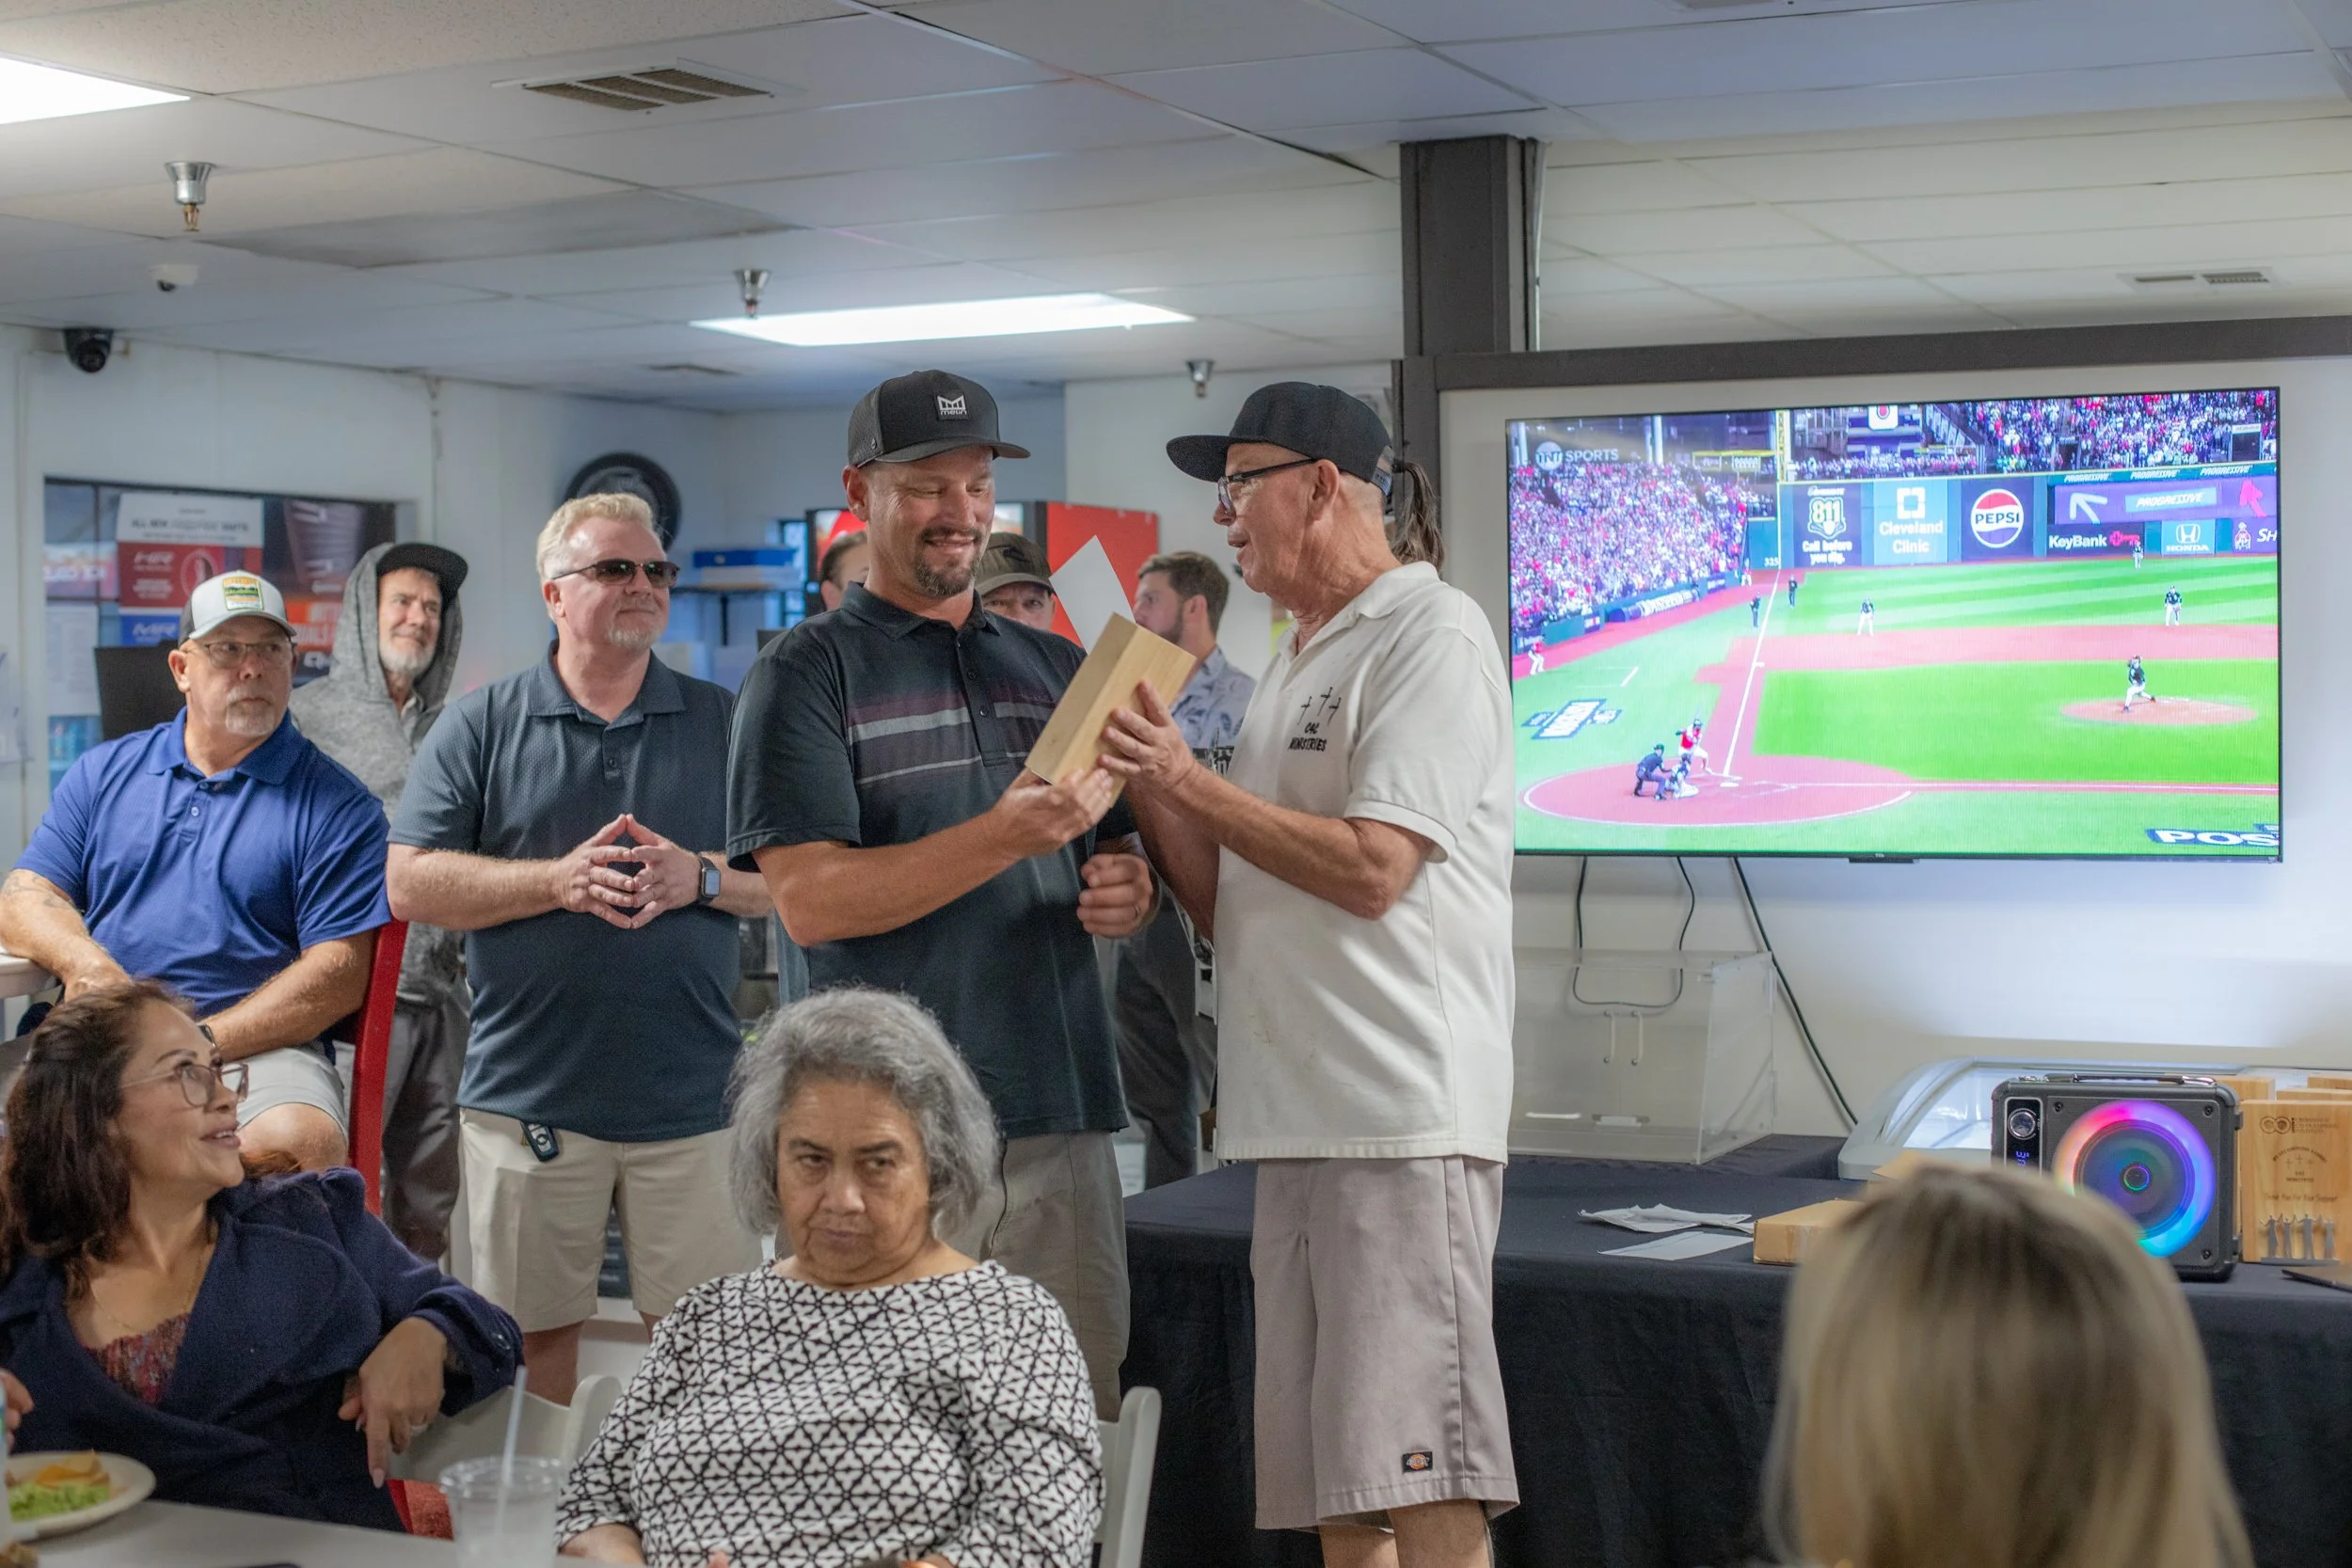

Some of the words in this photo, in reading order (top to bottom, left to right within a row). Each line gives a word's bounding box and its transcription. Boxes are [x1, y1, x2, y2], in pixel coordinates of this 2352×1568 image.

[1535, 451, 1563, 464] TNT
[1565, 449, 1619, 462] SPORTS
[2064, 473, 2111, 483] PROGRESSIVE
[2130, 469, 2180, 480] PROGRESSIVE
[2200, 465, 2253, 476] PROGRESSIVE
[2136, 490, 2206, 508] PROGRESSIVE
[1812, 499, 1841, 524] 811
[1975, 512, 2020, 525] PEPSI
[1879, 520, 1944, 535] Cleveland
[2048, 533, 2107, 550] KeyBank
[2257, 528, 2278, 543] SH
[1892, 538, 1931, 553] Clinic
[2166, 544, 2210, 552] HONDA
